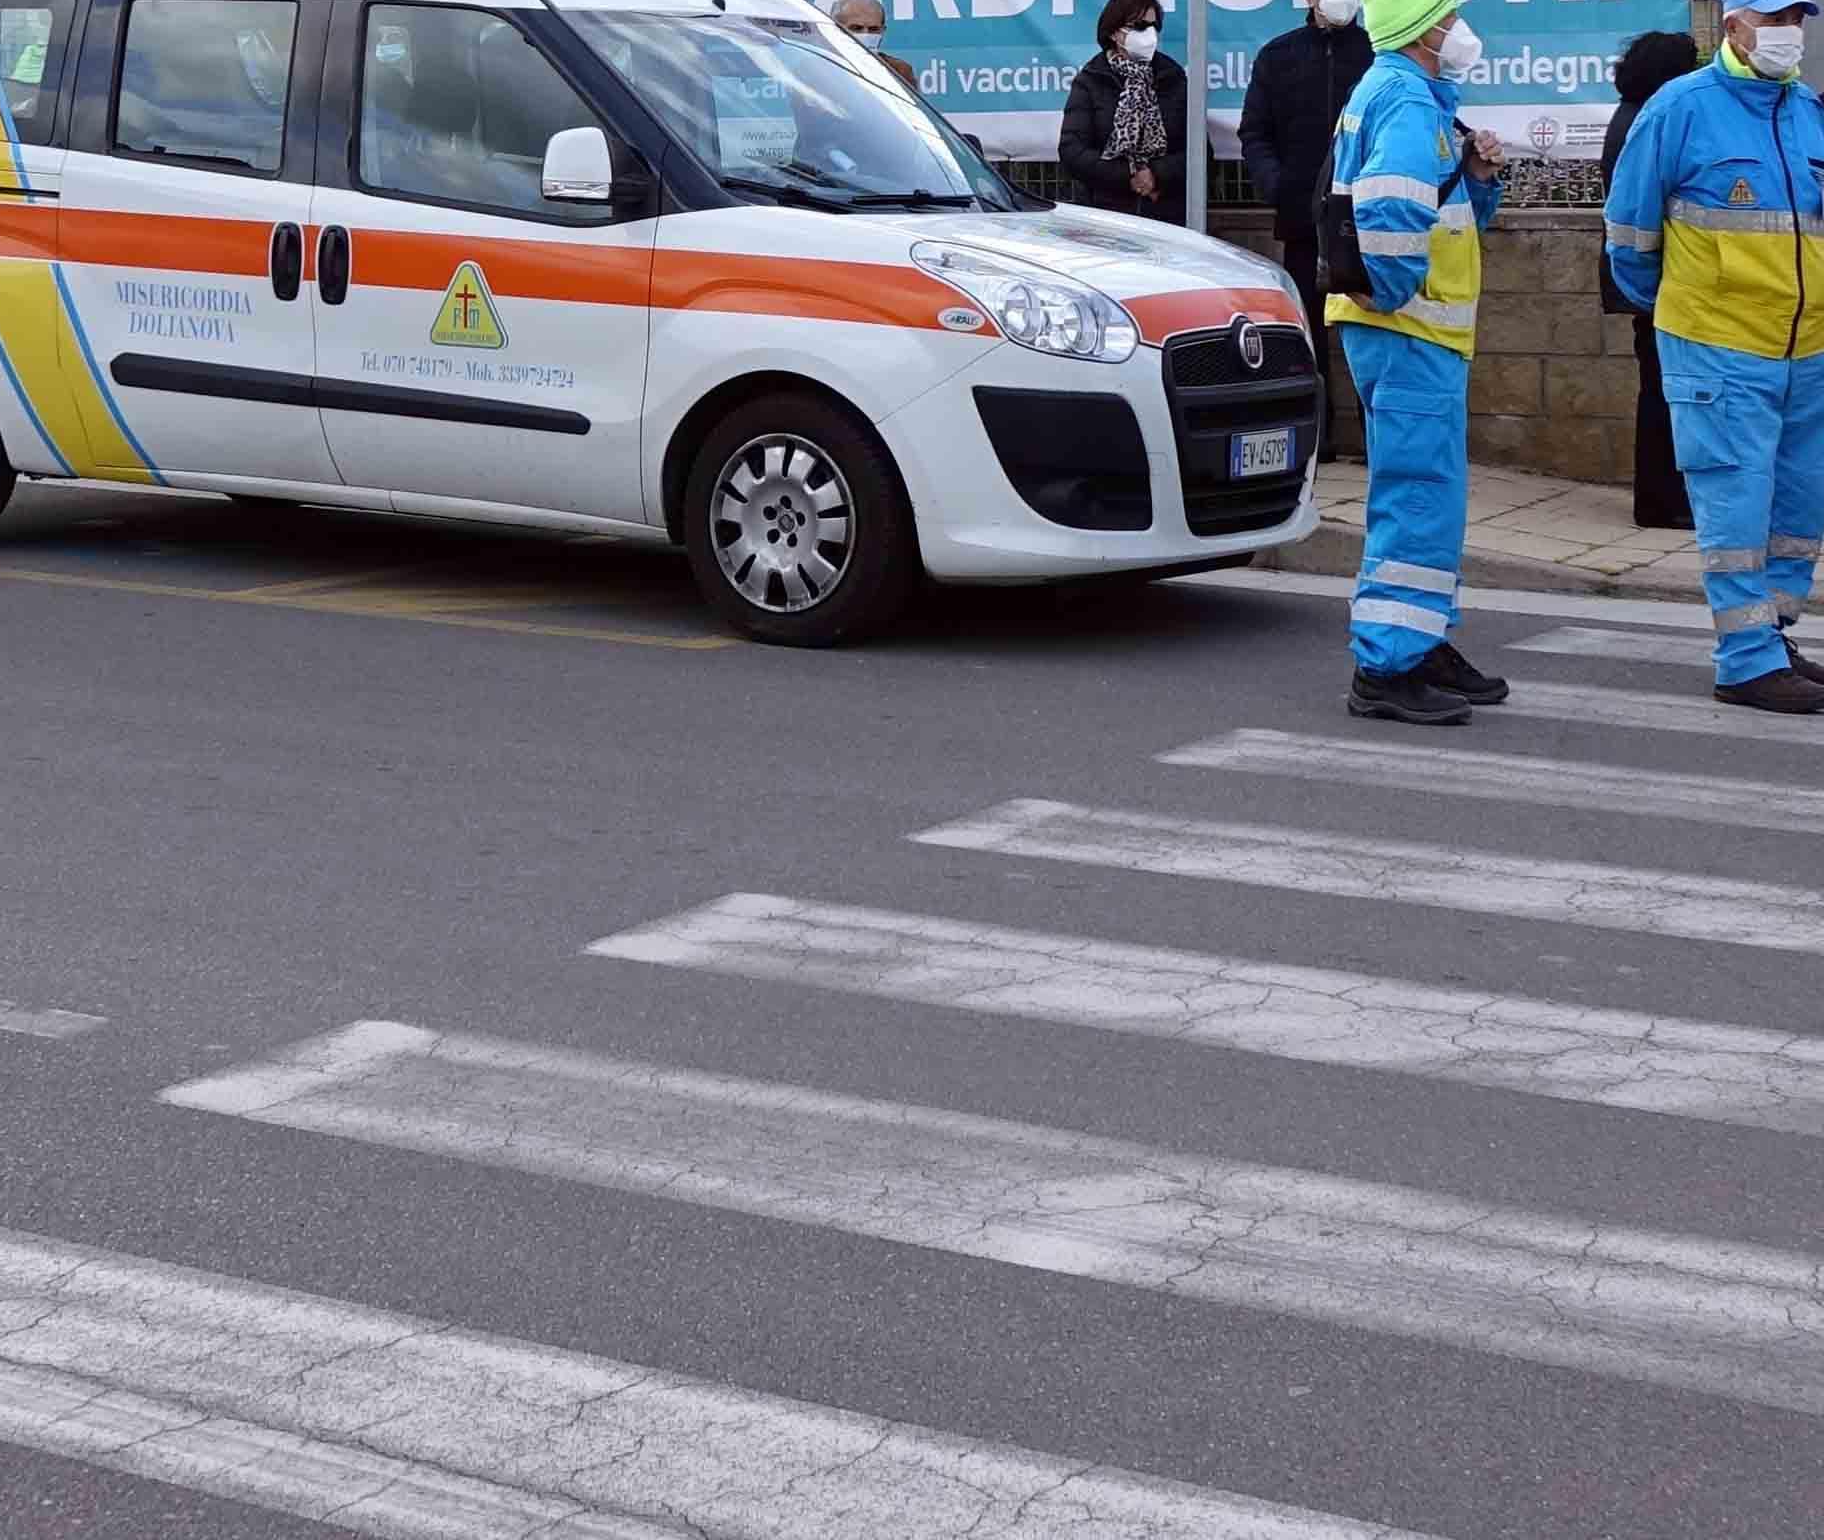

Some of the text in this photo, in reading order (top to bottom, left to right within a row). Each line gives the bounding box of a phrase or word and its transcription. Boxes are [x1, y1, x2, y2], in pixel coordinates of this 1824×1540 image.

[919, 59, 947, 95] di
[956, 58, 1084, 92] vaccina
[115, 281, 252, 316] MISERICORDIA
[130, 311, 234, 343] DOLIANOVA
